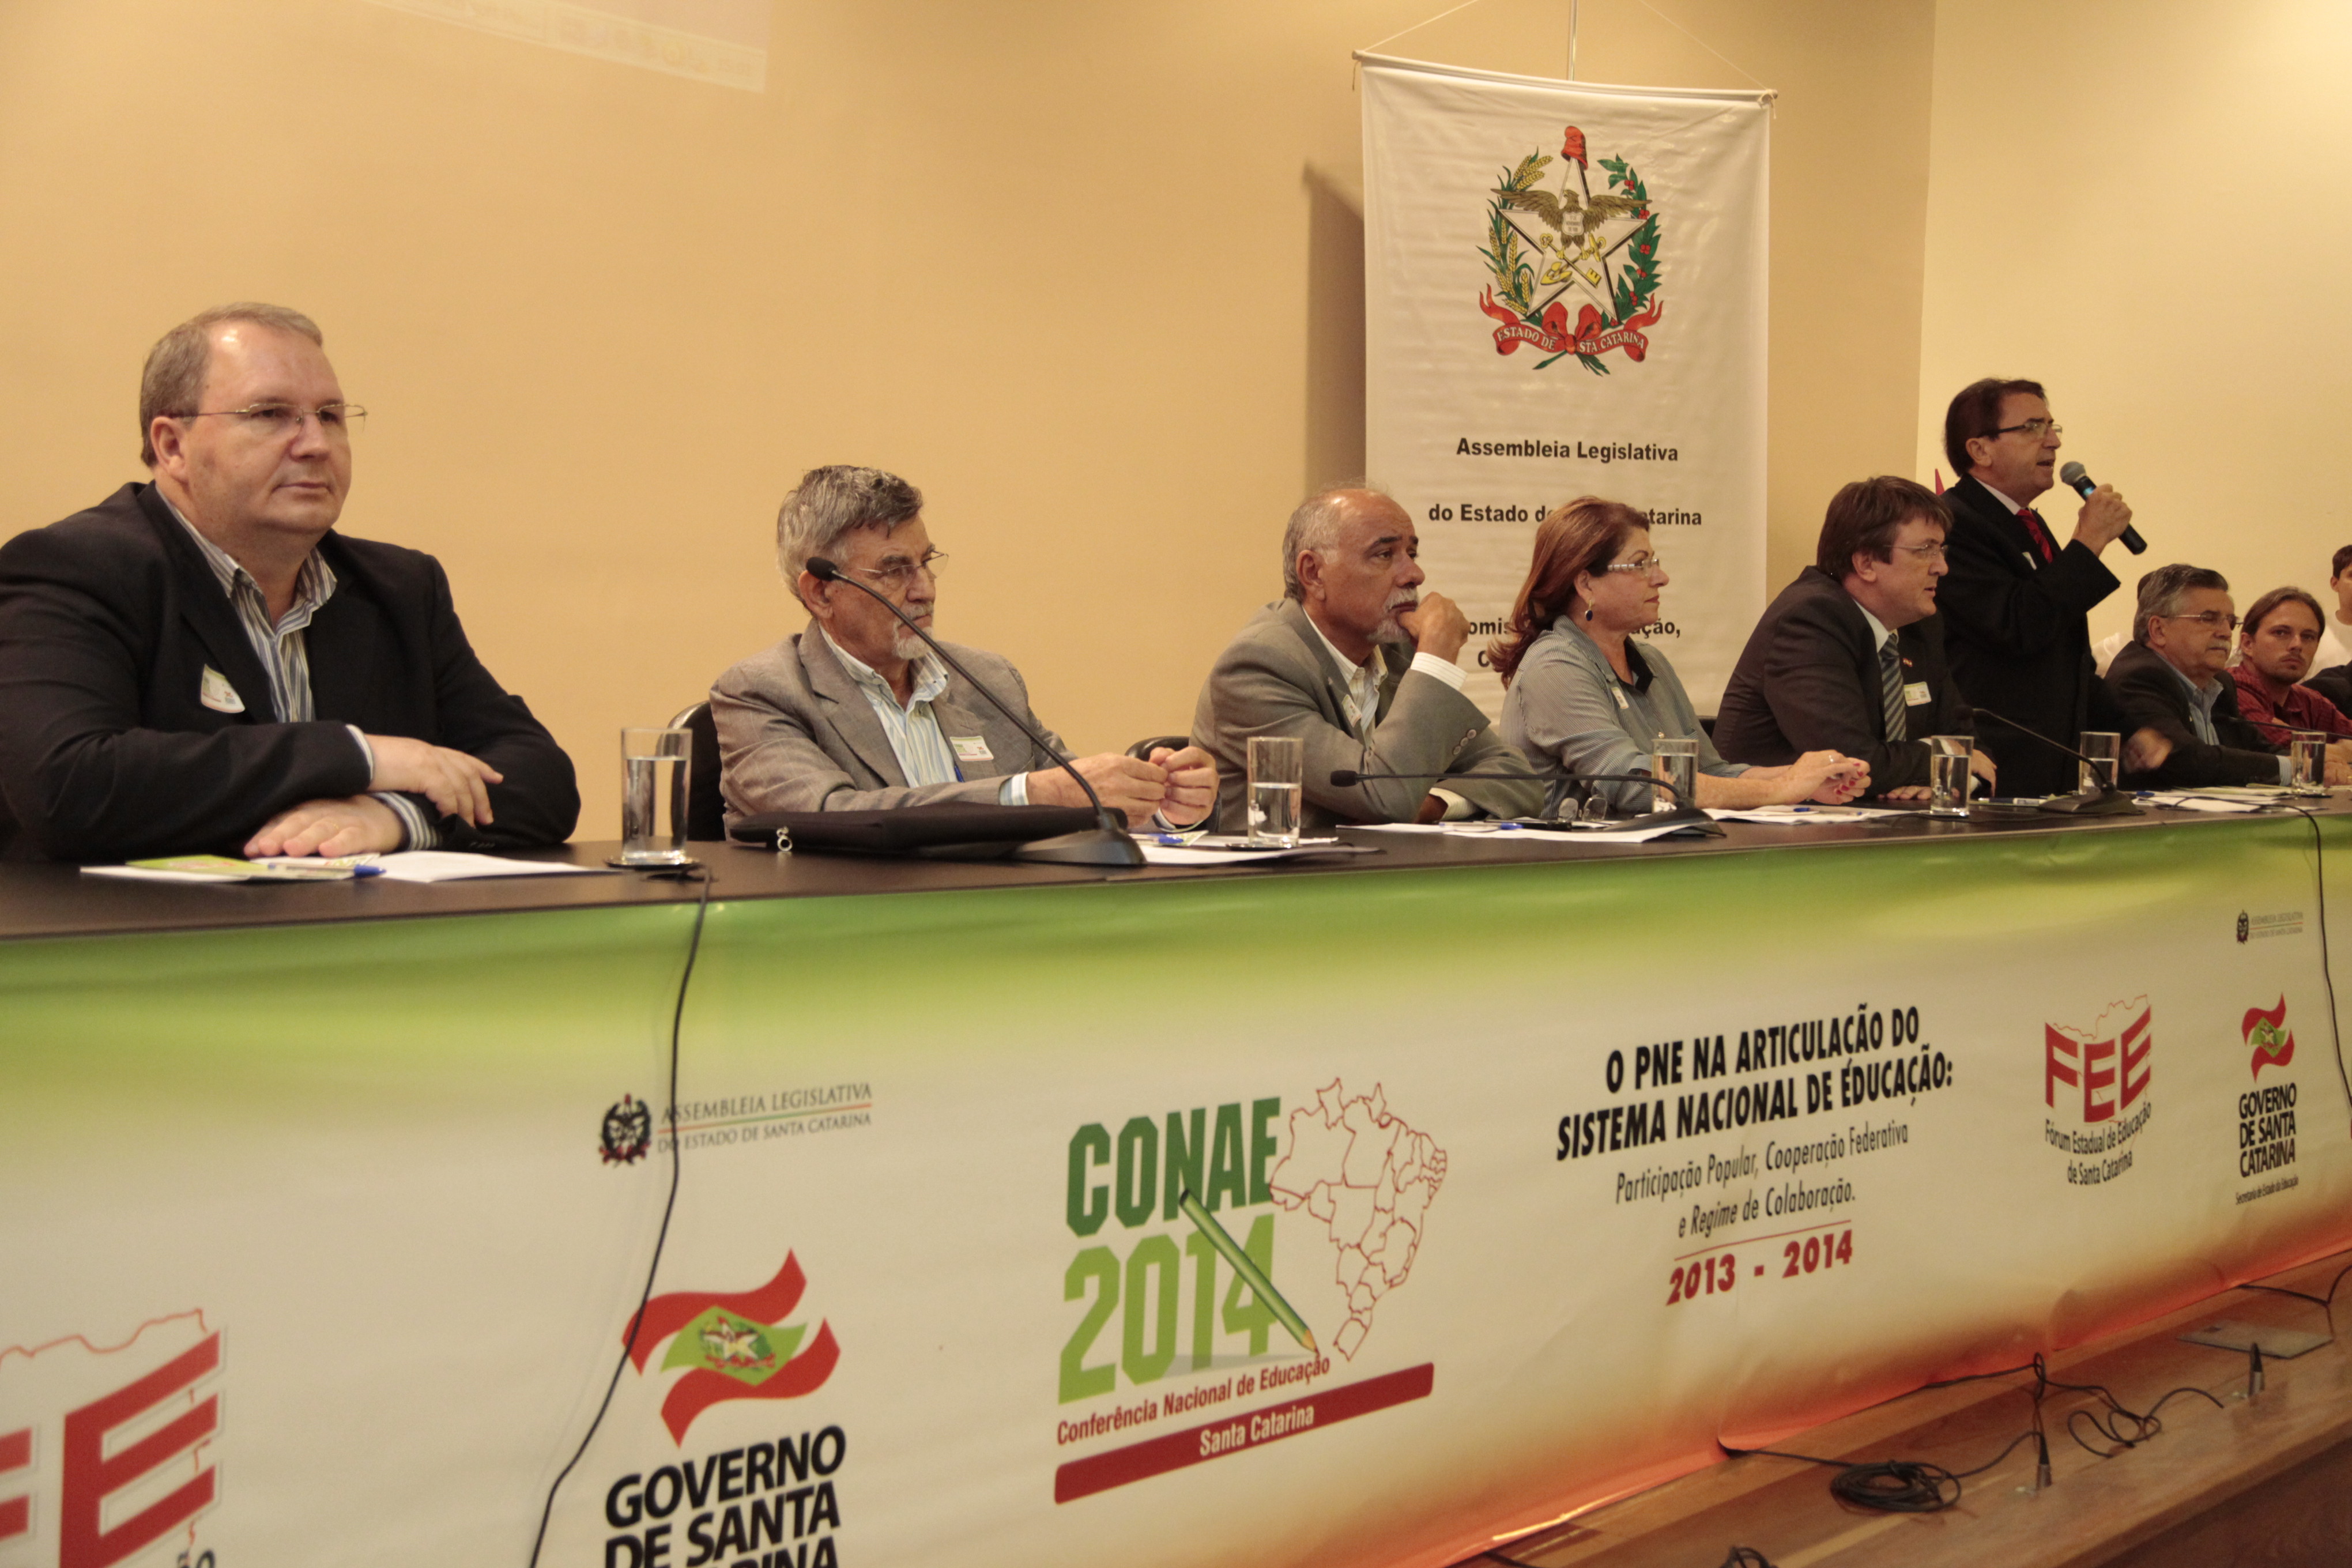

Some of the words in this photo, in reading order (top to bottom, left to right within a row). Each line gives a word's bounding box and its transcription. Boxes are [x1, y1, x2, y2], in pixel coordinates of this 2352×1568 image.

[1497, 327, 1539, 342] ESTADO
[1541, 337, 1555, 350] DE
[1600, 331, 1644, 349] CATARINA
[1457, 438, 1570, 458] Assembleia
[1577, 442, 1678, 463] Legislativa
[1429, 504, 1453, 521] do
[1461, 504, 1528, 522] Estado
[1642, 508, 1701, 525] tarina
[1605, 1049, 1624, 1094] O
[1635, 1041, 1683, 1090] PNE
[1693, 1035, 1727, 1080] NA
[1735, 1002, 1883, 1075] ARTICULAÇÃO
[1892, 1005, 1919, 1047] DO
[2045, 1004, 2151, 1123] FEE
[662, 1096, 766, 1124] ASSEMBLEIA
[772, 1083, 872, 1111] LEGISLATIVA
[1556, 1099, 1666, 1161] SISTEMA
[1676, 1077, 1798, 1140] NACIONAL
[1807, 1069, 1833, 1114] DE
[1841, 1043, 1953, 1107] EDUCAÇÃO:
[2239, 1082, 2297, 1120] GOVERNO
[2240, 1120, 2255, 1149] DE
[2258, 1110, 2296, 1144] SANTA
[685, 1128, 738, 1149] ESTADO
[741, 1126, 759, 1141] DE
[763, 1121, 805, 1140] SANTA
[808, 1113, 871, 1133] CATARINA
[2073, 1128, 2105, 1154] Estadual
[2107, 1126, 2116, 1149] de
[2240, 1138, 2296, 1178] CATARINA
[1066, 1096, 1281, 1238] CONAE
[1616, 1160, 1702, 1204] Participação
[1707, 1144, 1759, 1189] Popular,
[1765, 1133, 1845, 1175] Cooperação
[1849, 1118, 1909, 1156] Federativa
[2068, 1159, 2077, 1184] de
[2079, 1162, 2100, 1185] Santa
[2102, 1151, 2132, 1182] Catarina
[1678, 1215, 1686, 1239] e
[1690, 1200, 1737, 1239] Regime
[1743, 1189, 1759, 1222] de
[1765, 1177, 1856, 1216] Colaboração.
[1666, 1253, 1736, 1306] 2013
[1782, 1229, 1853, 1279] 2014
[1058, 1213, 1277, 1405] 2014
[1057, 1402, 1158, 1446] Conferência
[1163, 1378, 1231, 1417] Nacional
[1237, 1371, 1254, 1396] de
[1260, 1356, 1330, 1390] Educação
[1200, 1424, 1246, 1457] Santa
[1250, 1403, 1315, 1441] Catarina
[606, 1425, 846, 1528] GOVERNO
[687, 1480, 840, 1567] SANTA
